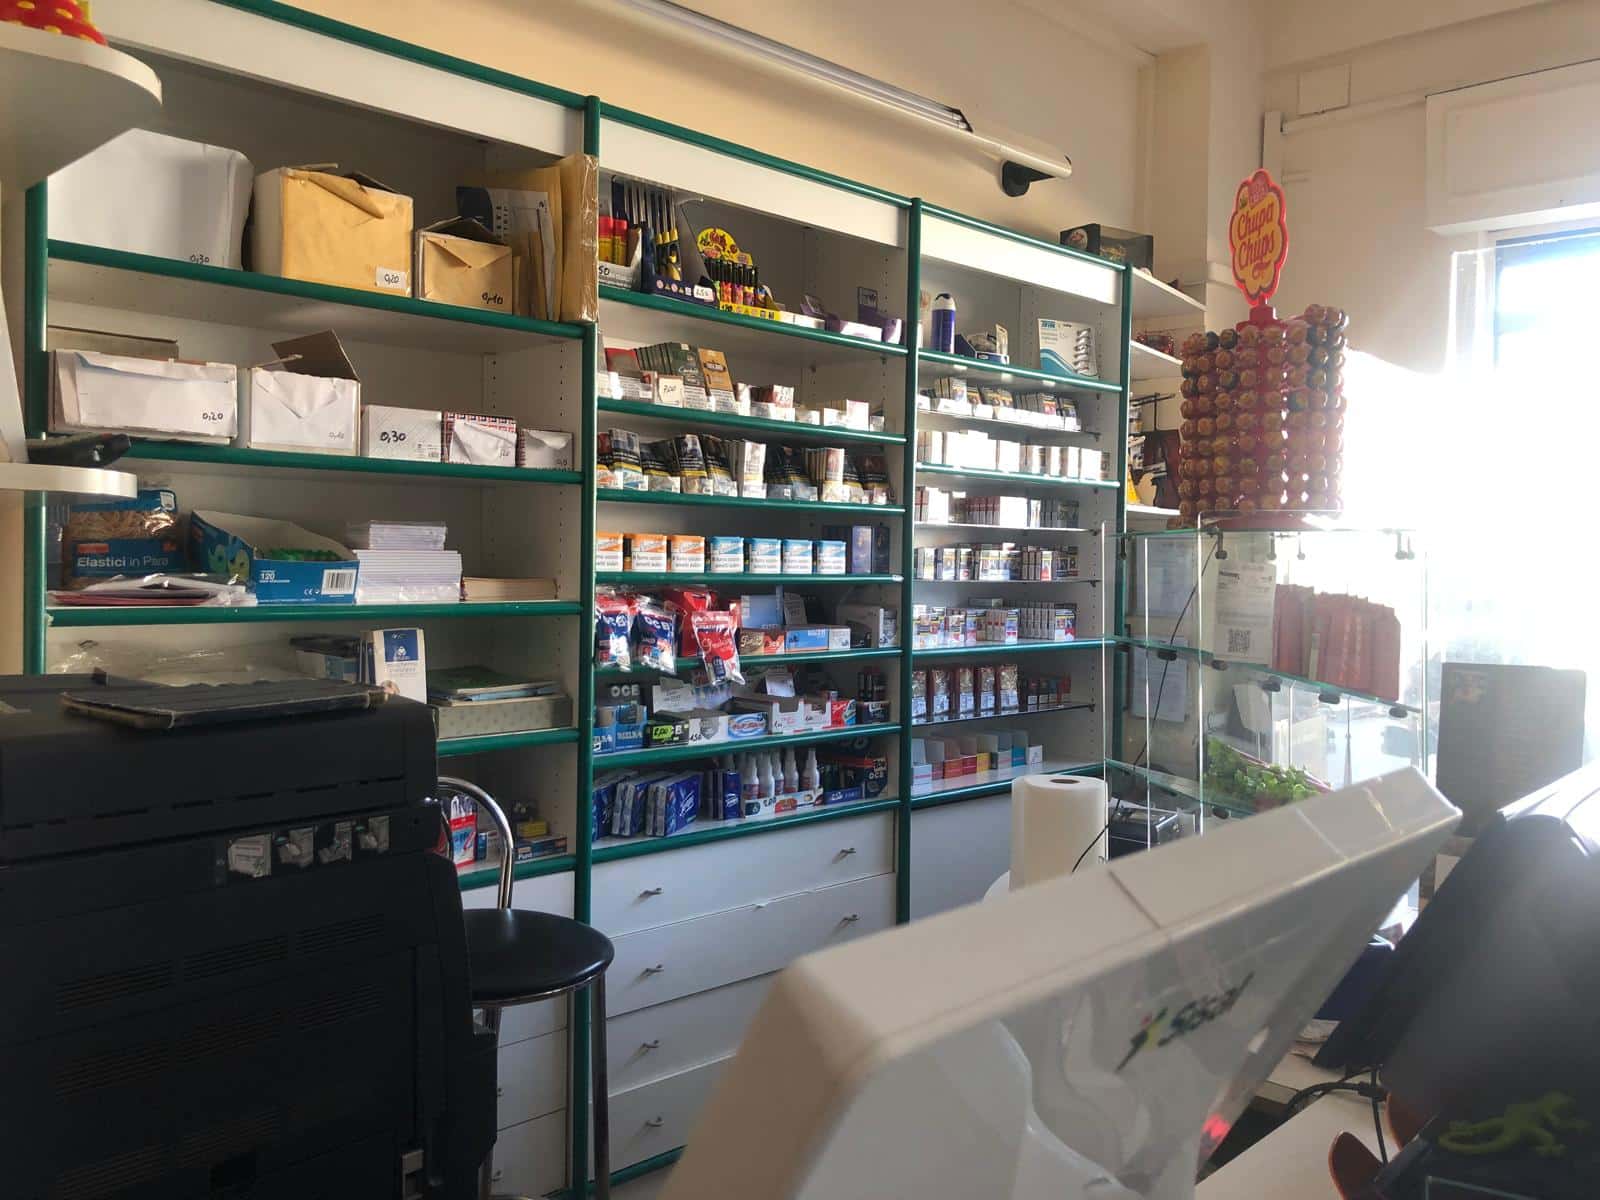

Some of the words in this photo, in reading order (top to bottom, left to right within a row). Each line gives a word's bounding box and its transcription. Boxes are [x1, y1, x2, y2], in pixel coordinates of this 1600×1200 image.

[1237, 203, 1274, 241] Chupa
[1238, 230, 1274, 270] Chups
[202, 411, 224, 421] 0,20
[380, 430, 407, 444] 0,30
[77, 555, 126, 568] Elastici
[130, 556, 140, 568] in
